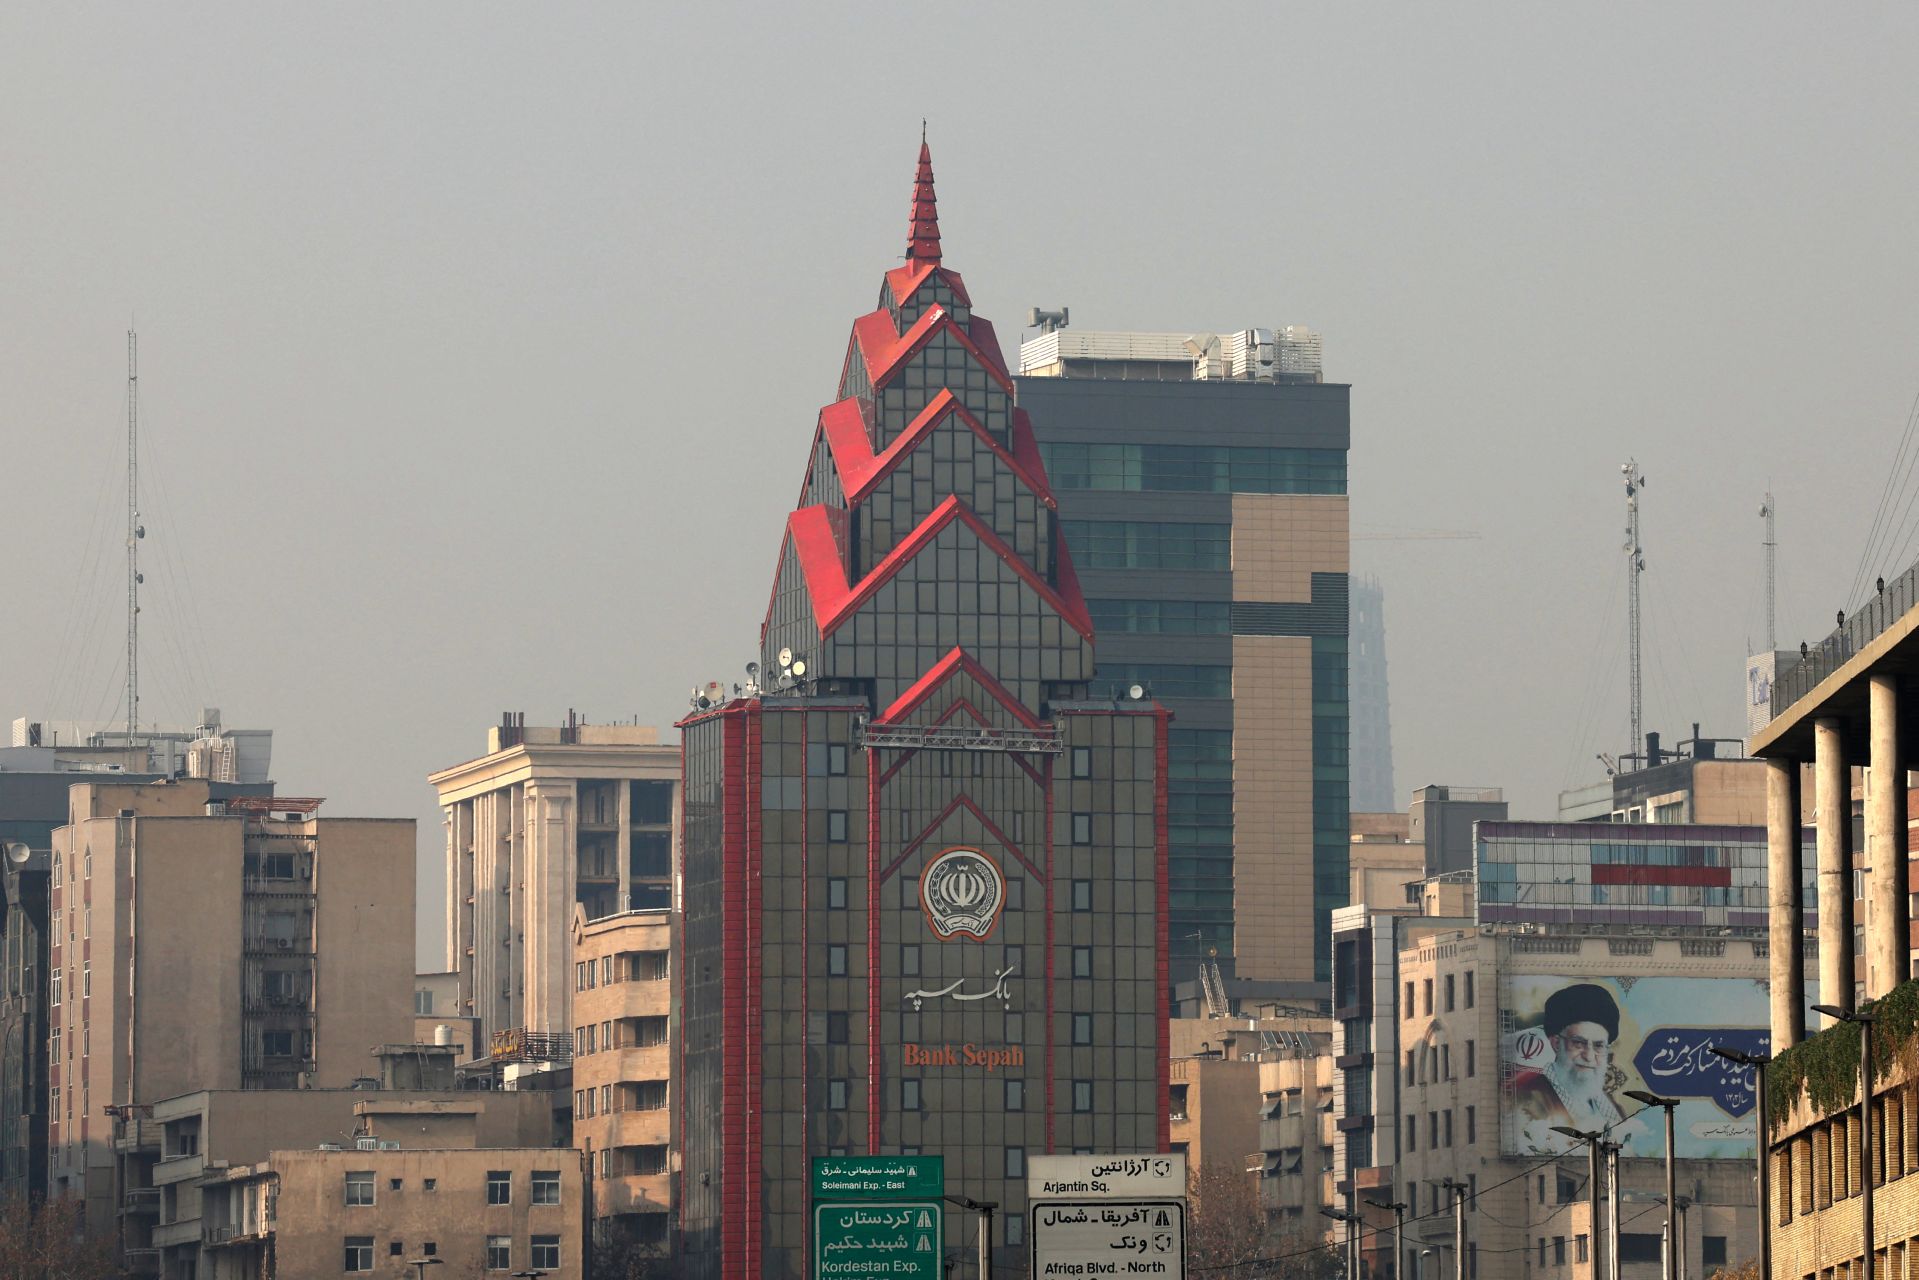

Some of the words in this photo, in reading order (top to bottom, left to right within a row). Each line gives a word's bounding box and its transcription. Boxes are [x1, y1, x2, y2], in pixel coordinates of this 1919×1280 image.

[904, 978, 965, 1011] سپه
[952, 966, 1014, 1010] بانک
[904, 1043, 959, 1066] Bank
[963, 1043, 1025, 1072] Sepah
[1652, 1044, 1691, 1066] مردم
[1732, 1091, 1749, 1108] سال
[821, 1164, 842, 1177] شرق
[847, 1165, 882, 1177] سلیمانی
[884, 1164, 905, 1176] شهید
[1091, 1158, 1150, 1177] آرژانتین
[822, 1181, 862, 1190] Soleimani
[863, 1181, 881, 1191] Exp.
[887, 1181, 905, 1189] East
[1043, 1181, 1089, 1193] Arjantin
[1091, 1181, 1110, 1193] Sq.
[840, 1210, 913, 1229] کردستان
[1043, 1208, 1088, 1227] شمال
[1101, 1208, 1150, 1227] آفریقا
[824, 1235, 864, 1257] حکیم
[866, 1234, 908, 1253] شهید
[1109, 1235, 1148, 1254] ونک
[821, 1260, 889, 1273] Kordestan
[893, 1260, 921, 1274] Exp.
[1045, 1262, 1083, 1276] Afriqa
[1087, 1261, 1118, 1274] Blvd.
[1127, 1261, 1166, 1273] North
